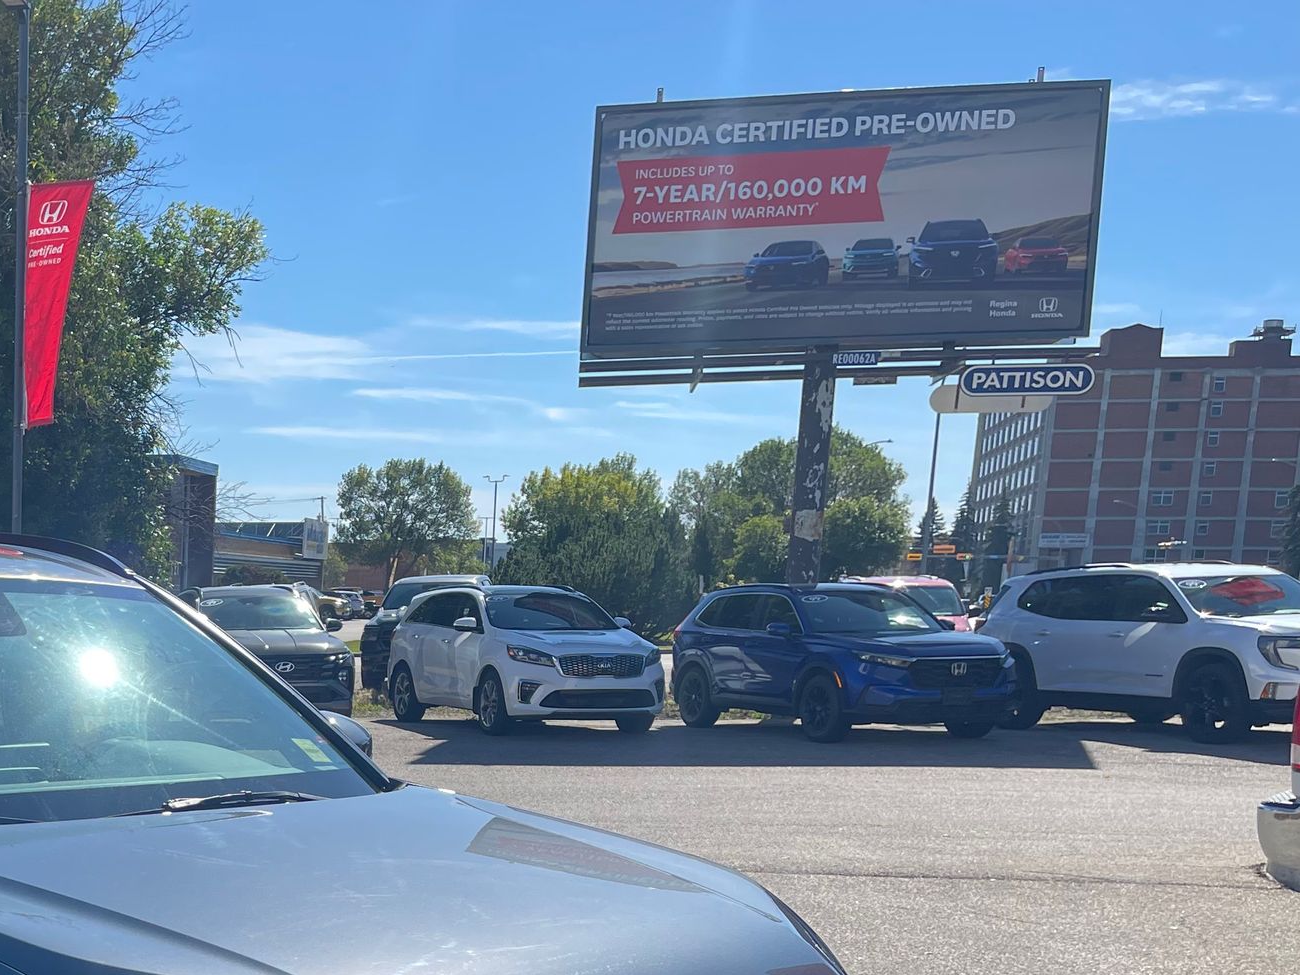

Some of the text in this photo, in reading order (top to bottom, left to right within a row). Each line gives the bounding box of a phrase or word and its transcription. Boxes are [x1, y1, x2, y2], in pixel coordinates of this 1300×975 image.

[618, 108, 1016, 150] HONDA CERTIFIED PRE-OWNED
[635, 164, 734, 179] INCLUDES UP TO
[633, 174, 867, 205] 7-YEAR/160,000 KM
[632, 208, 727, 224] POWERTRAIN
[28, 225, 70, 238] HONDA
[28, 243, 64, 259] Certified
[989, 299, 1018, 309] Regina
[989, 309, 1016, 317] Honda
[832, 353, 876, 364] RE00062A
[971, 370, 1084, 389] PATTISON
